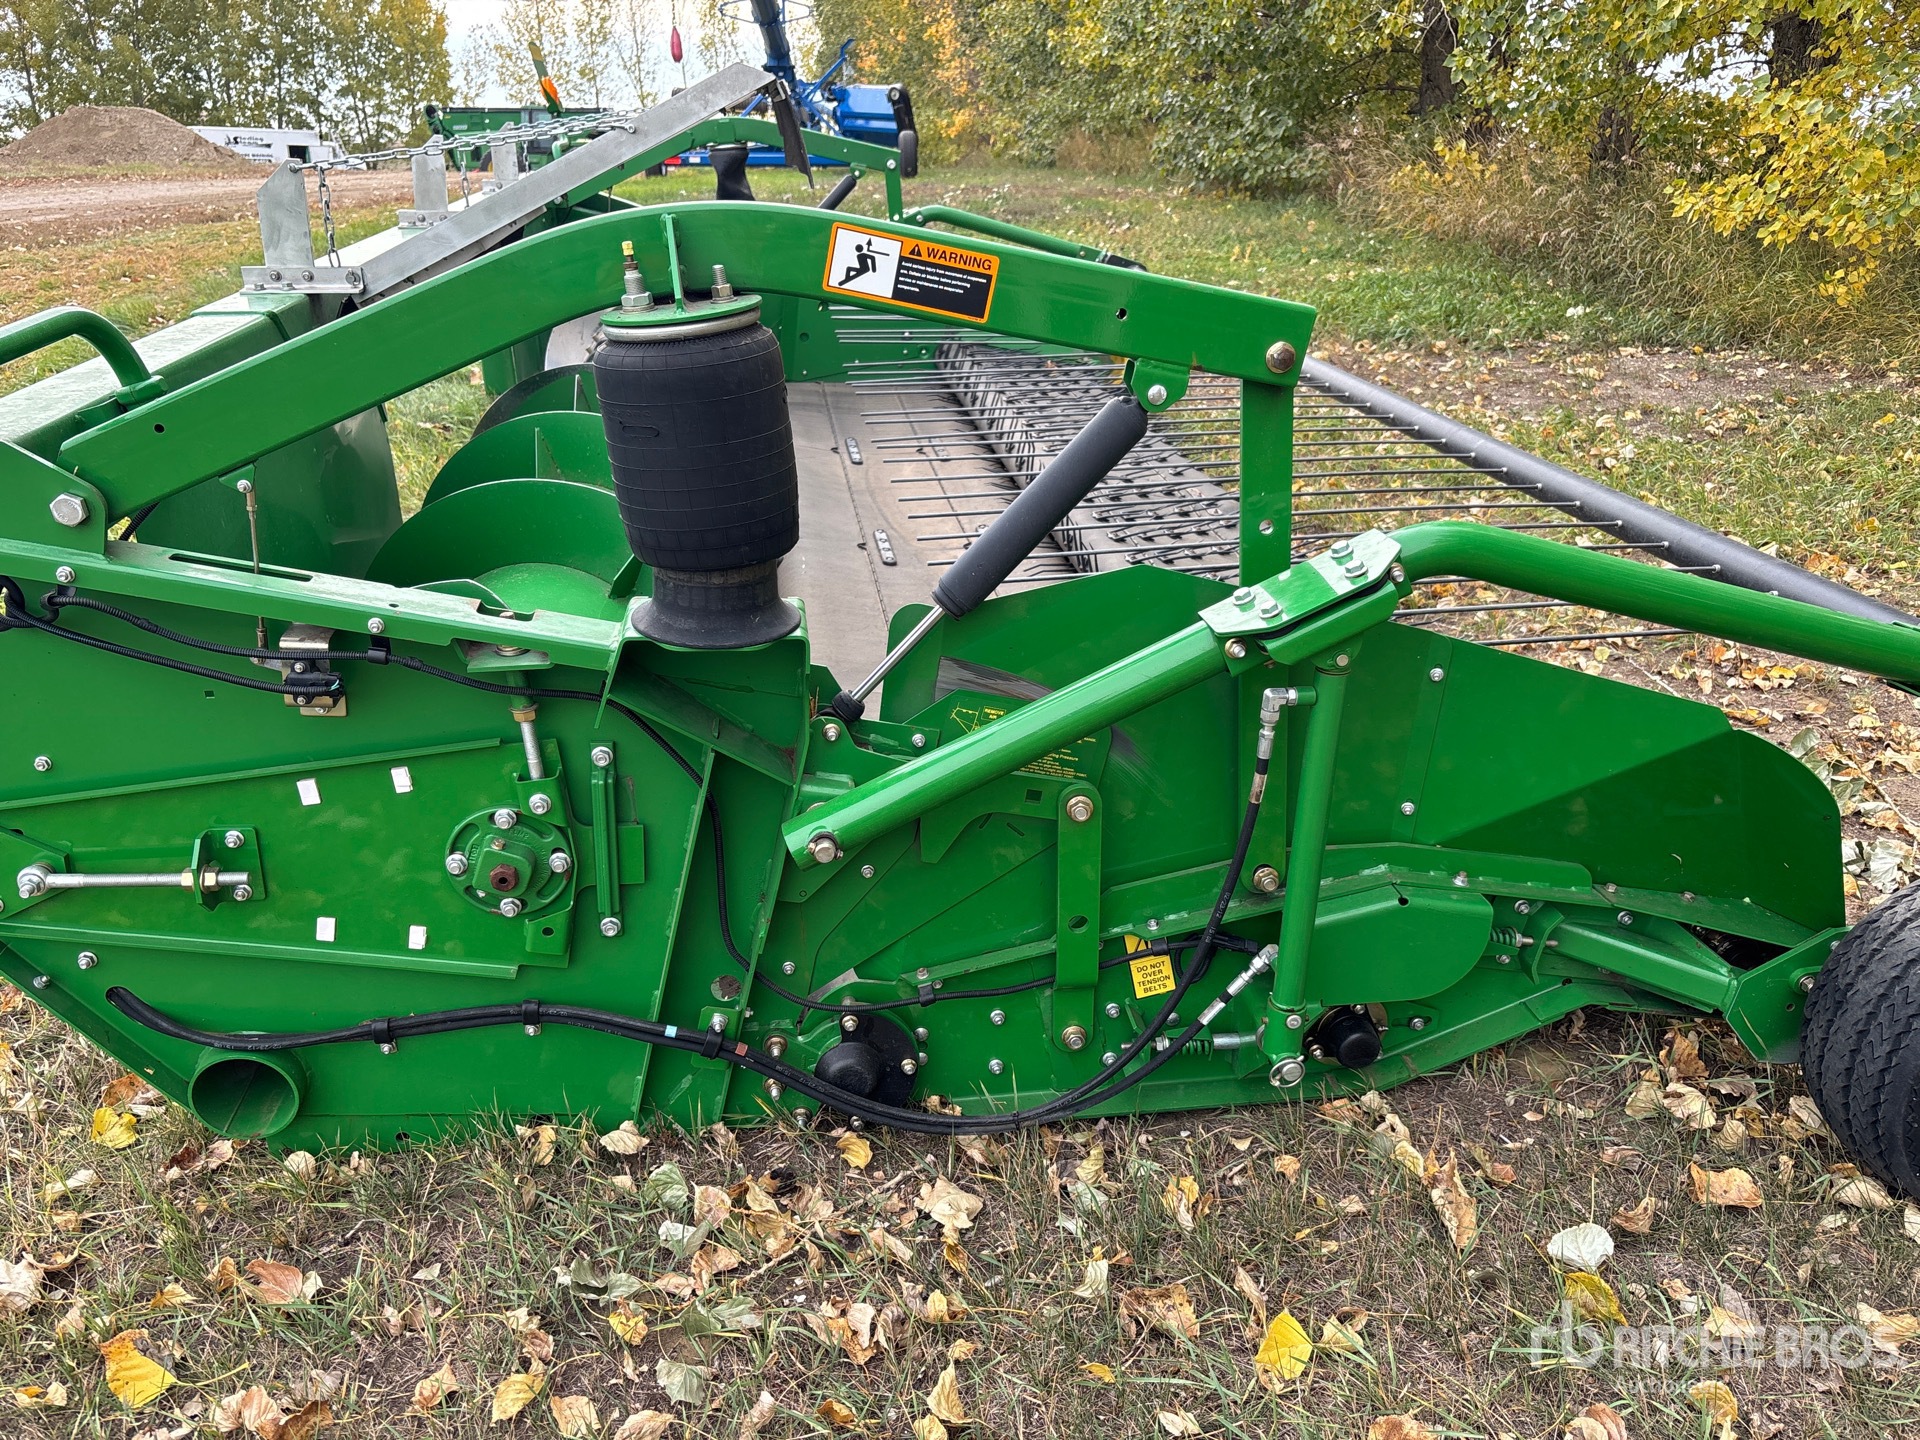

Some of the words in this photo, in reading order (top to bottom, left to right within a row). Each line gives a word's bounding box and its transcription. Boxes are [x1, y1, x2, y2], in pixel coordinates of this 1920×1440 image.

[927, 246, 992, 271] WARNING
[984, 708, 1004, 716] REMOVE
[1136, 965, 1148, 973] DO
[1149, 960, 1166, 970] NOT
[1142, 968, 1164, 979] OVER
[1137, 974, 1171, 988] TENSION
[1143, 982, 1168, 994] BELTS
